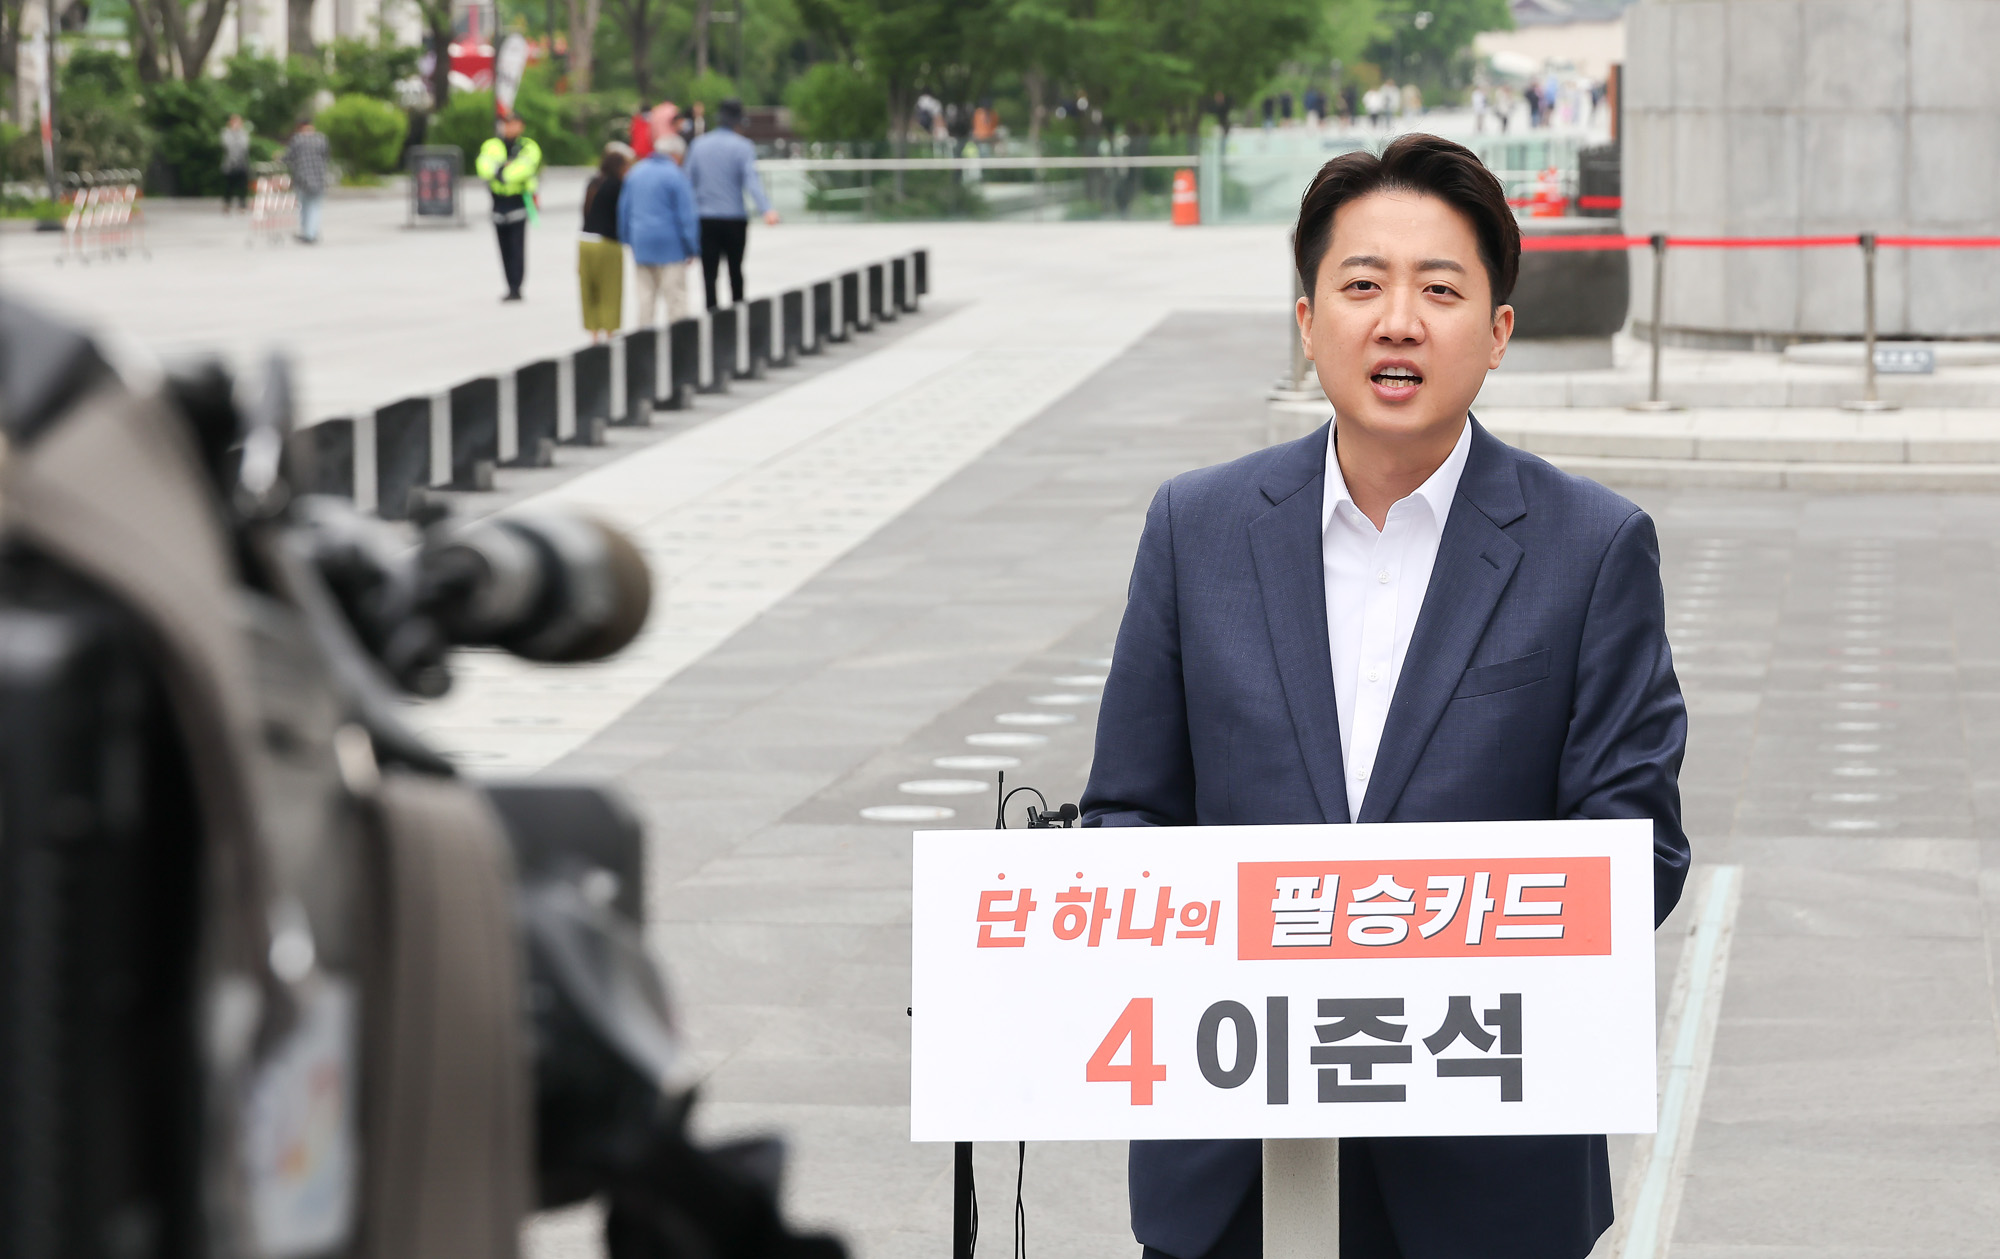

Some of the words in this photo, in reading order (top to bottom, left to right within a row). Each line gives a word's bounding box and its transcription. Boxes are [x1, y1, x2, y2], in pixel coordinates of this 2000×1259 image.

[976, 887, 1038, 948] 단
[1052, 886, 1221, 948] 하나의
[1270, 871, 1567, 946] 필승카드
[1086, 997, 1167, 1106] 4
[1196, 993, 1523, 1105] 이준석
